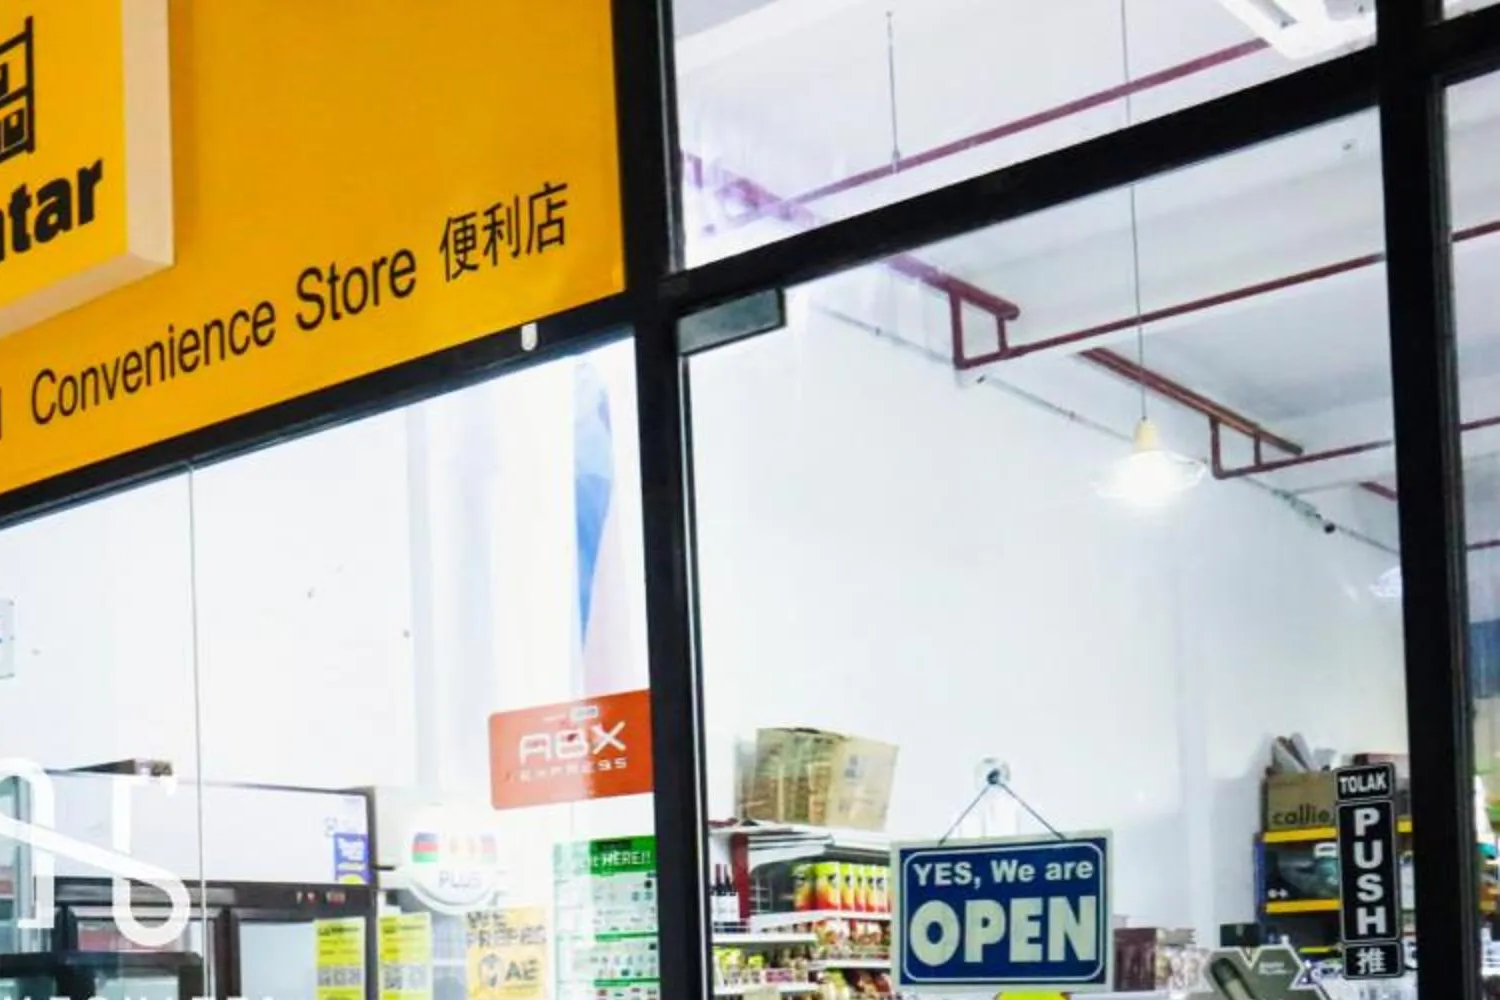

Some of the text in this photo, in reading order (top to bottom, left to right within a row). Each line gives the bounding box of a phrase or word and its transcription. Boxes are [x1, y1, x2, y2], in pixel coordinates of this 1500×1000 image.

[439, 180, 567, 282] 便利店
[31, 300, 276, 426] Convenience
[295, 248, 416, 331] Store
[519, 720, 627, 764] ABX
[1340, 772, 1387, 793] TOLAK
[913, 859, 1093, 890] YES, We are
[1353, 807, 1387, 935] PUSH
[909, 895, 1097, 967] OPEN
[1356, 947, 1387, 974] 推
